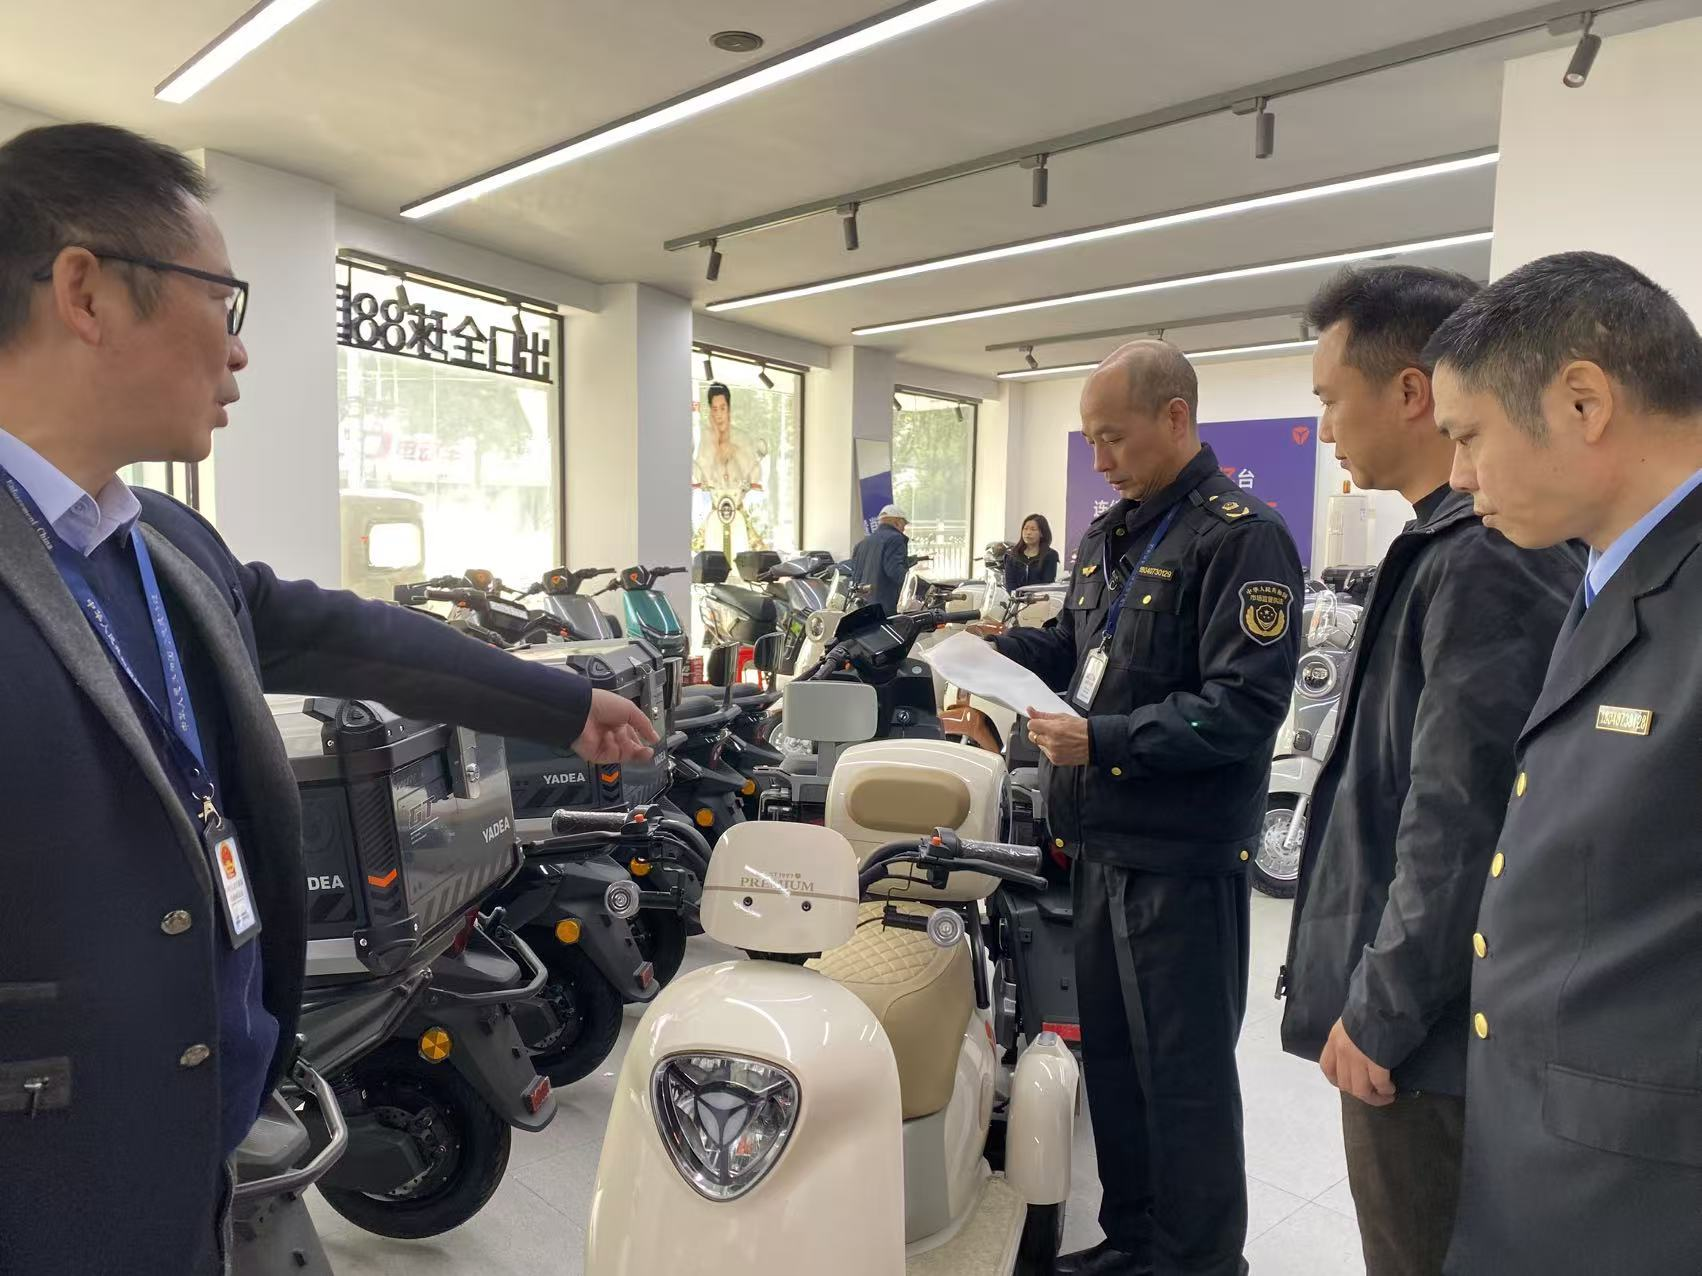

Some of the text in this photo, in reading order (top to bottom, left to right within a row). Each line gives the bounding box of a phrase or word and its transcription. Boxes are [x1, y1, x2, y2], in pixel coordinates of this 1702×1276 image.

[543, 772, 586, 785] YADEA
[482, 816, 511, 844] YADEA
[307, 874, 345, 891] DEA
